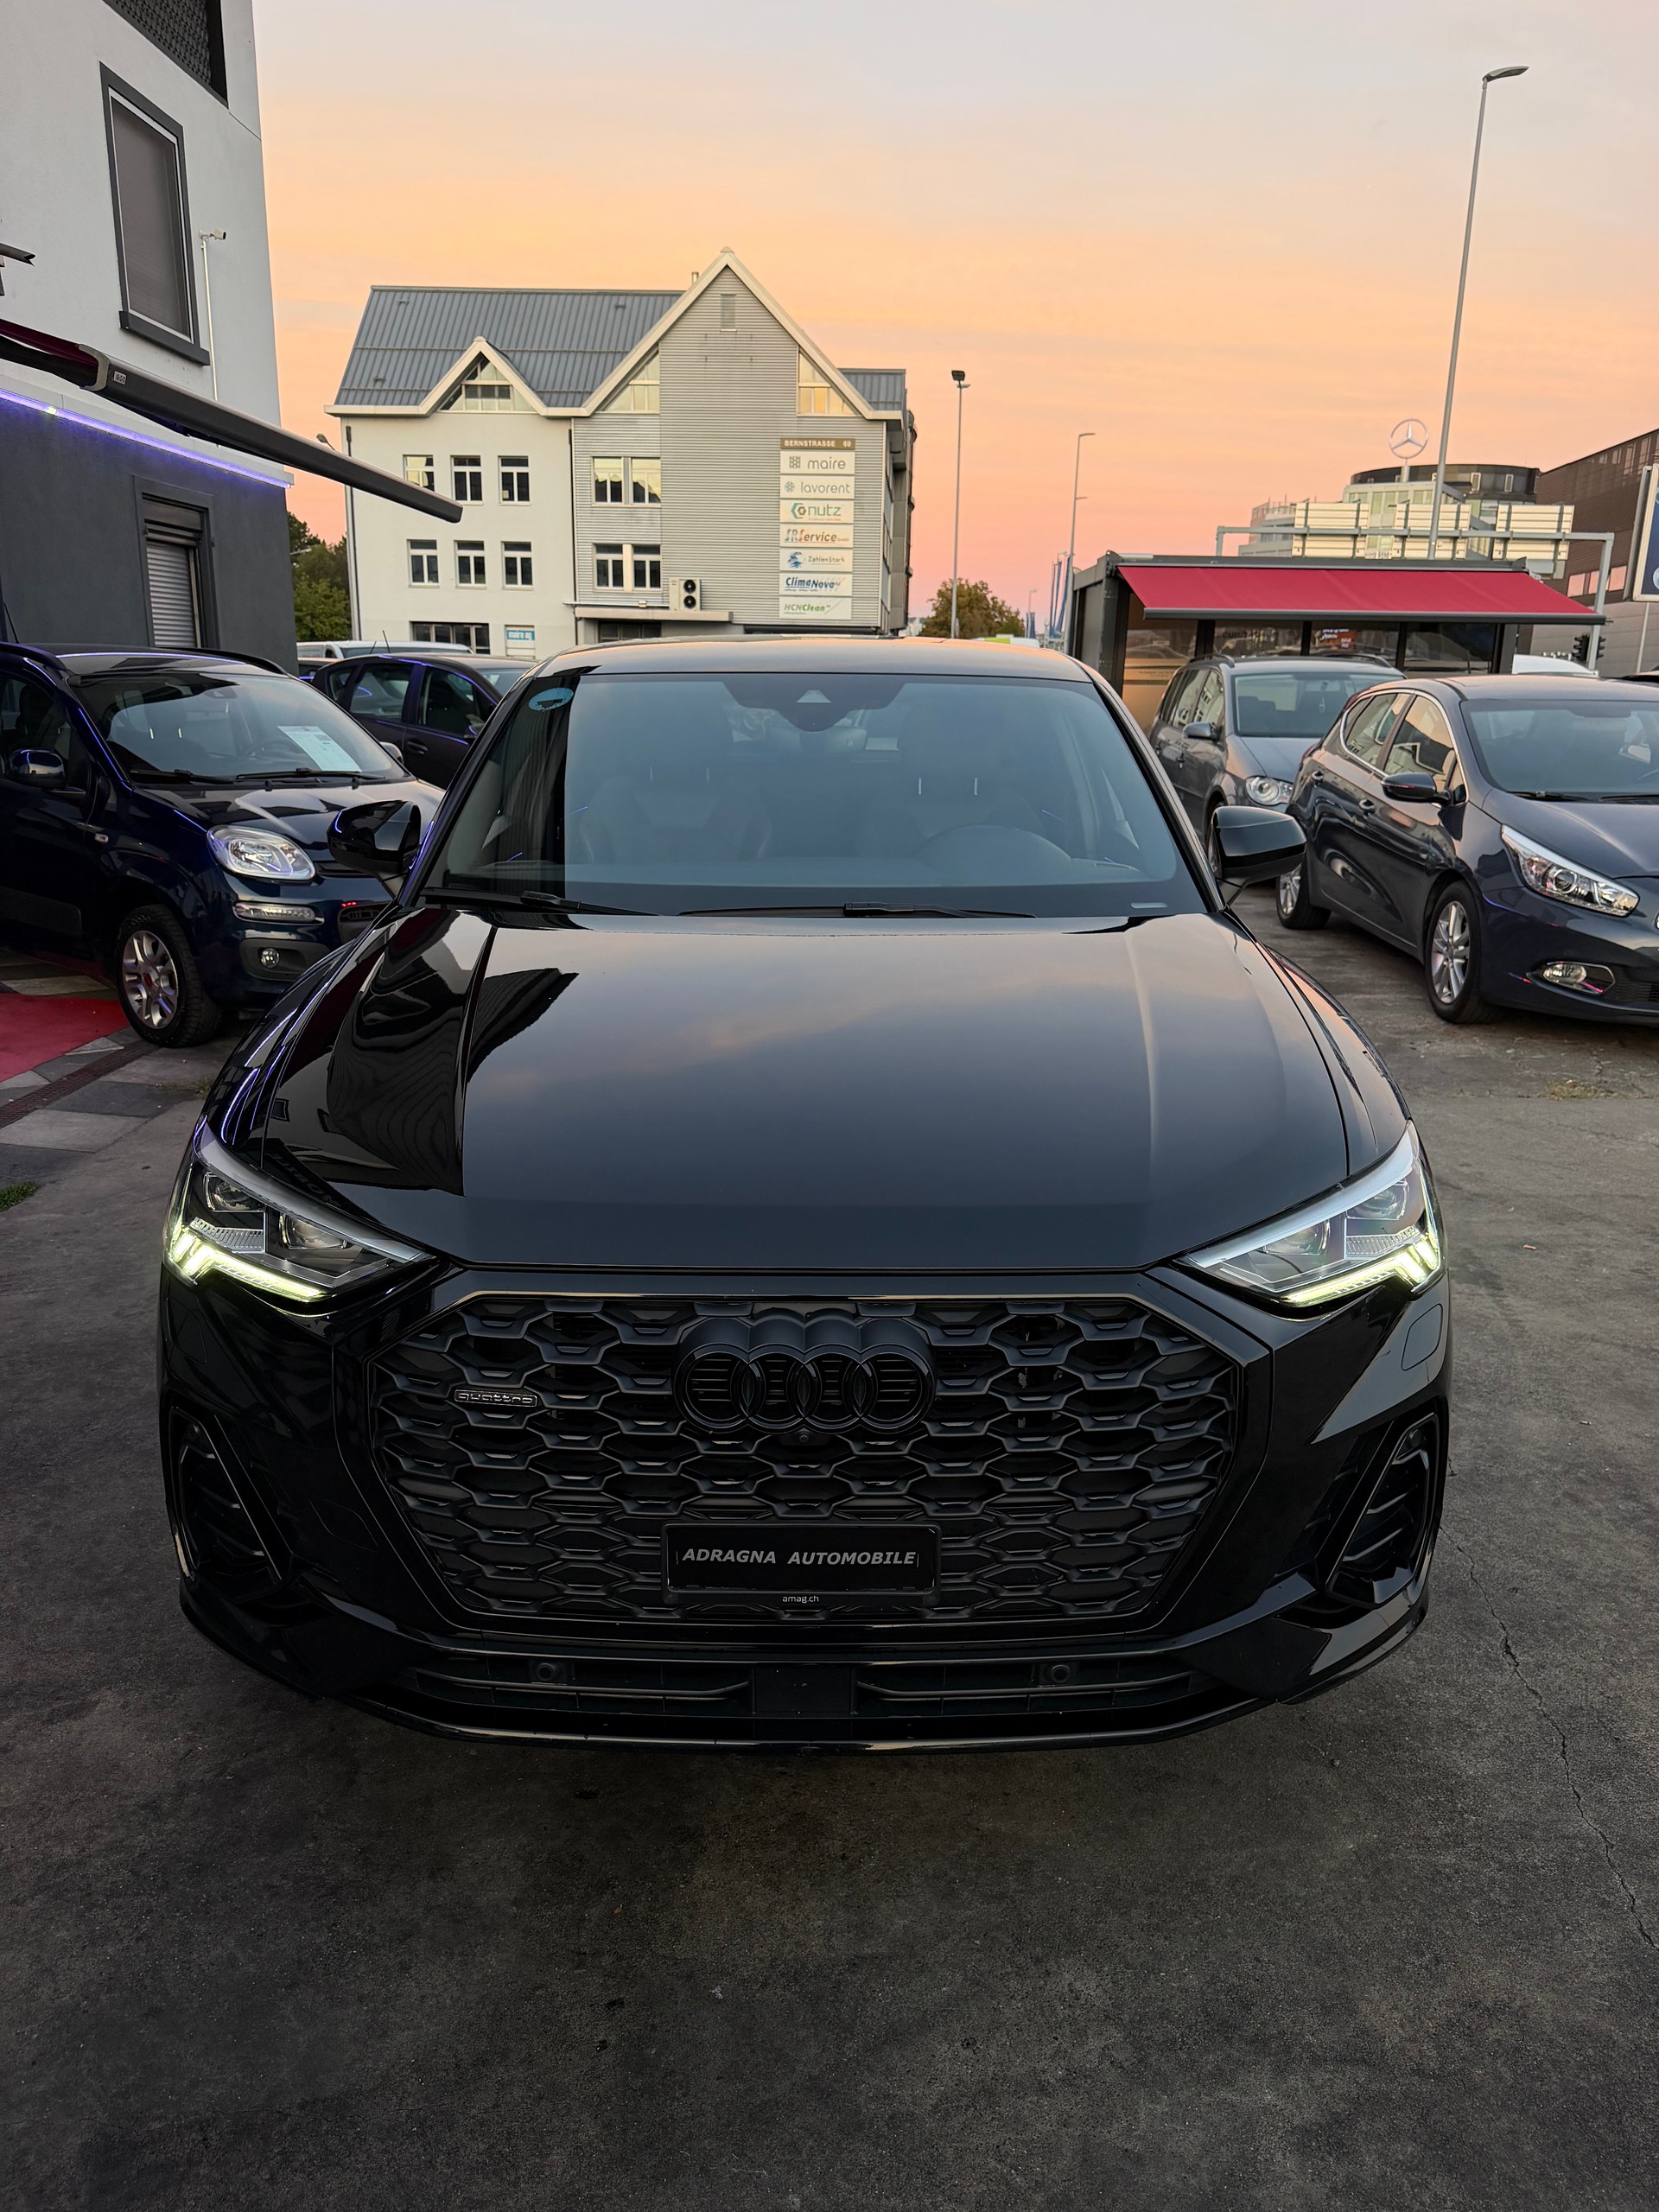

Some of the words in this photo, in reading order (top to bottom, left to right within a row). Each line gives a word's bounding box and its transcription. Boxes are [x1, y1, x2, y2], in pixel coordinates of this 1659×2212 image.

[784, 439, 836, 448] BERNSTRASSE
[807, 456, 846, 469] maire
[800, 481, 850, 493] lavorent
[785, 577, 836, 588] ClimaNova
[458, 1392, 533, 1404] quattro
[682, 1548, 777, 1565] ADRAGNA
[787, 1551, 917, 1565] AUTOMOBILE
[782, 1593, 819, 1604] amag.ch
